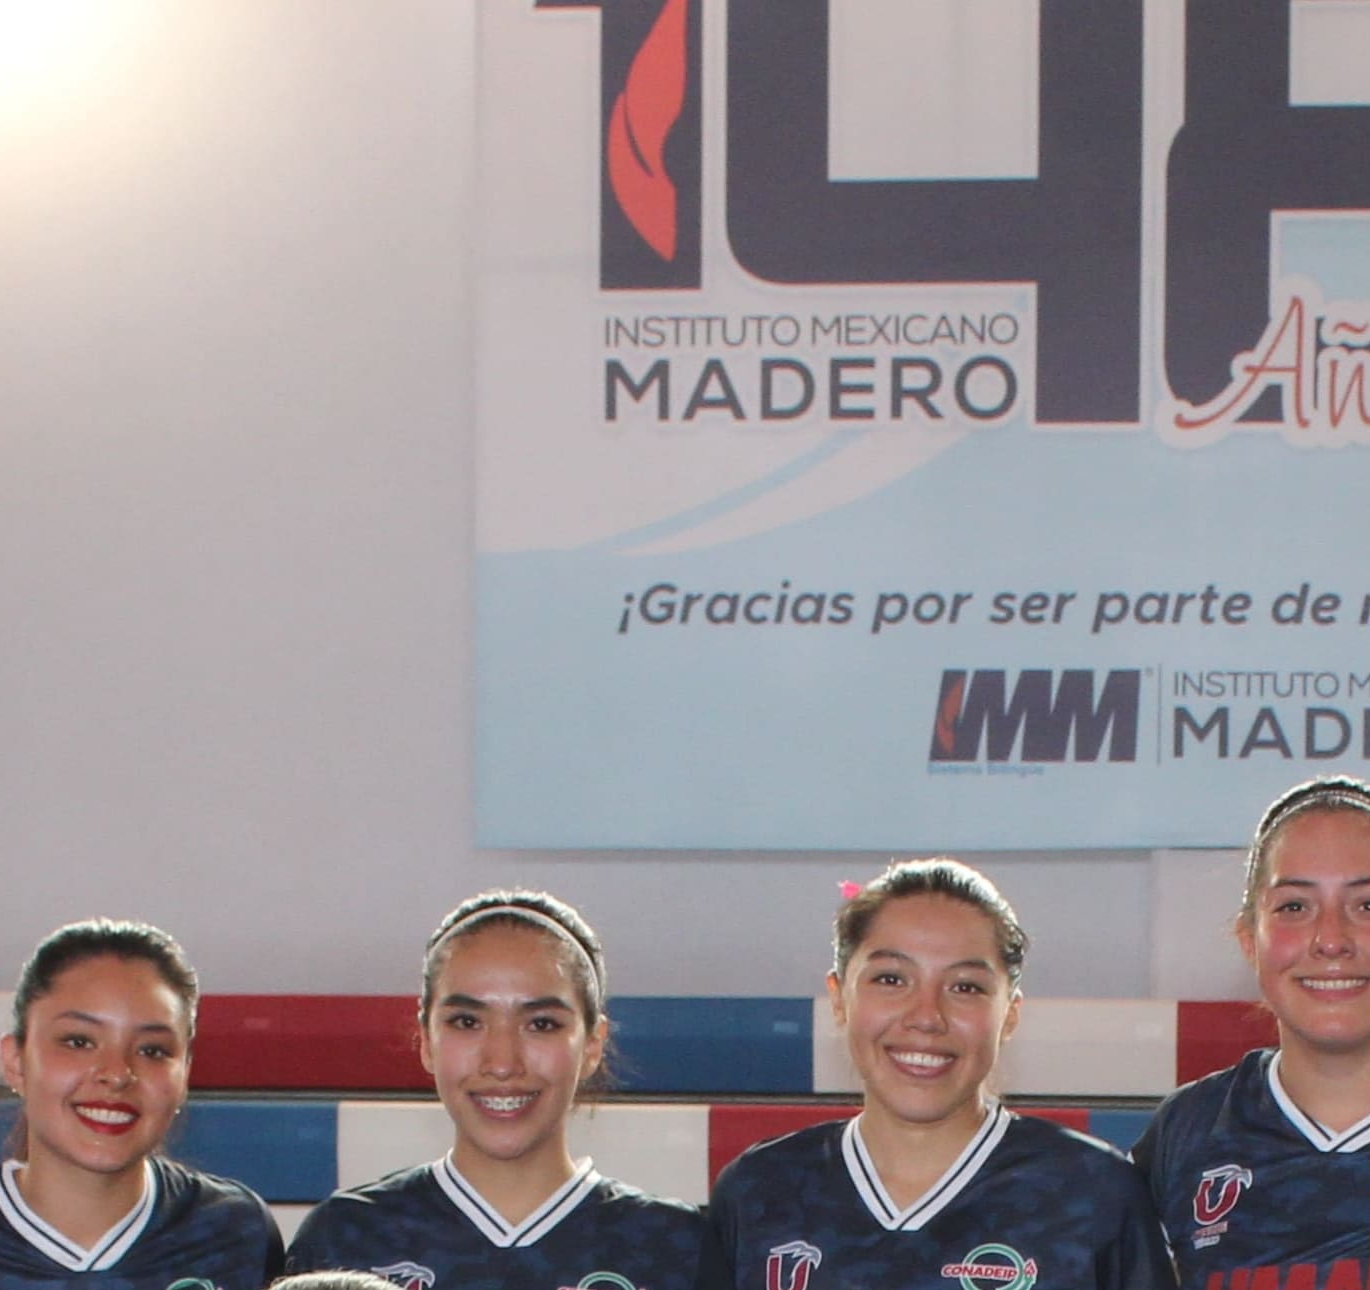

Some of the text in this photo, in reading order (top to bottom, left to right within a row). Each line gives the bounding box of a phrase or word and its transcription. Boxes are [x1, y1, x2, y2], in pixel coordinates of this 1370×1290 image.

[604, 313, 1019, 348] INSTITUTO MEXICANO
[604, 355, 1019, 422] MADERO
[617, 581, 855, 634] ¡Gracias
[871, 591, 973, 634] por
[989, 591, 1077, 625] ser
[1092, 585, 1252, 634] parte
[1271, 583, 1342, 626] de
[1173, 672, 1339, 698] INSTITUTO
[929, 669, 1141, 762] IMM
[941, 1263, 1018, 1281] CONADEIP
